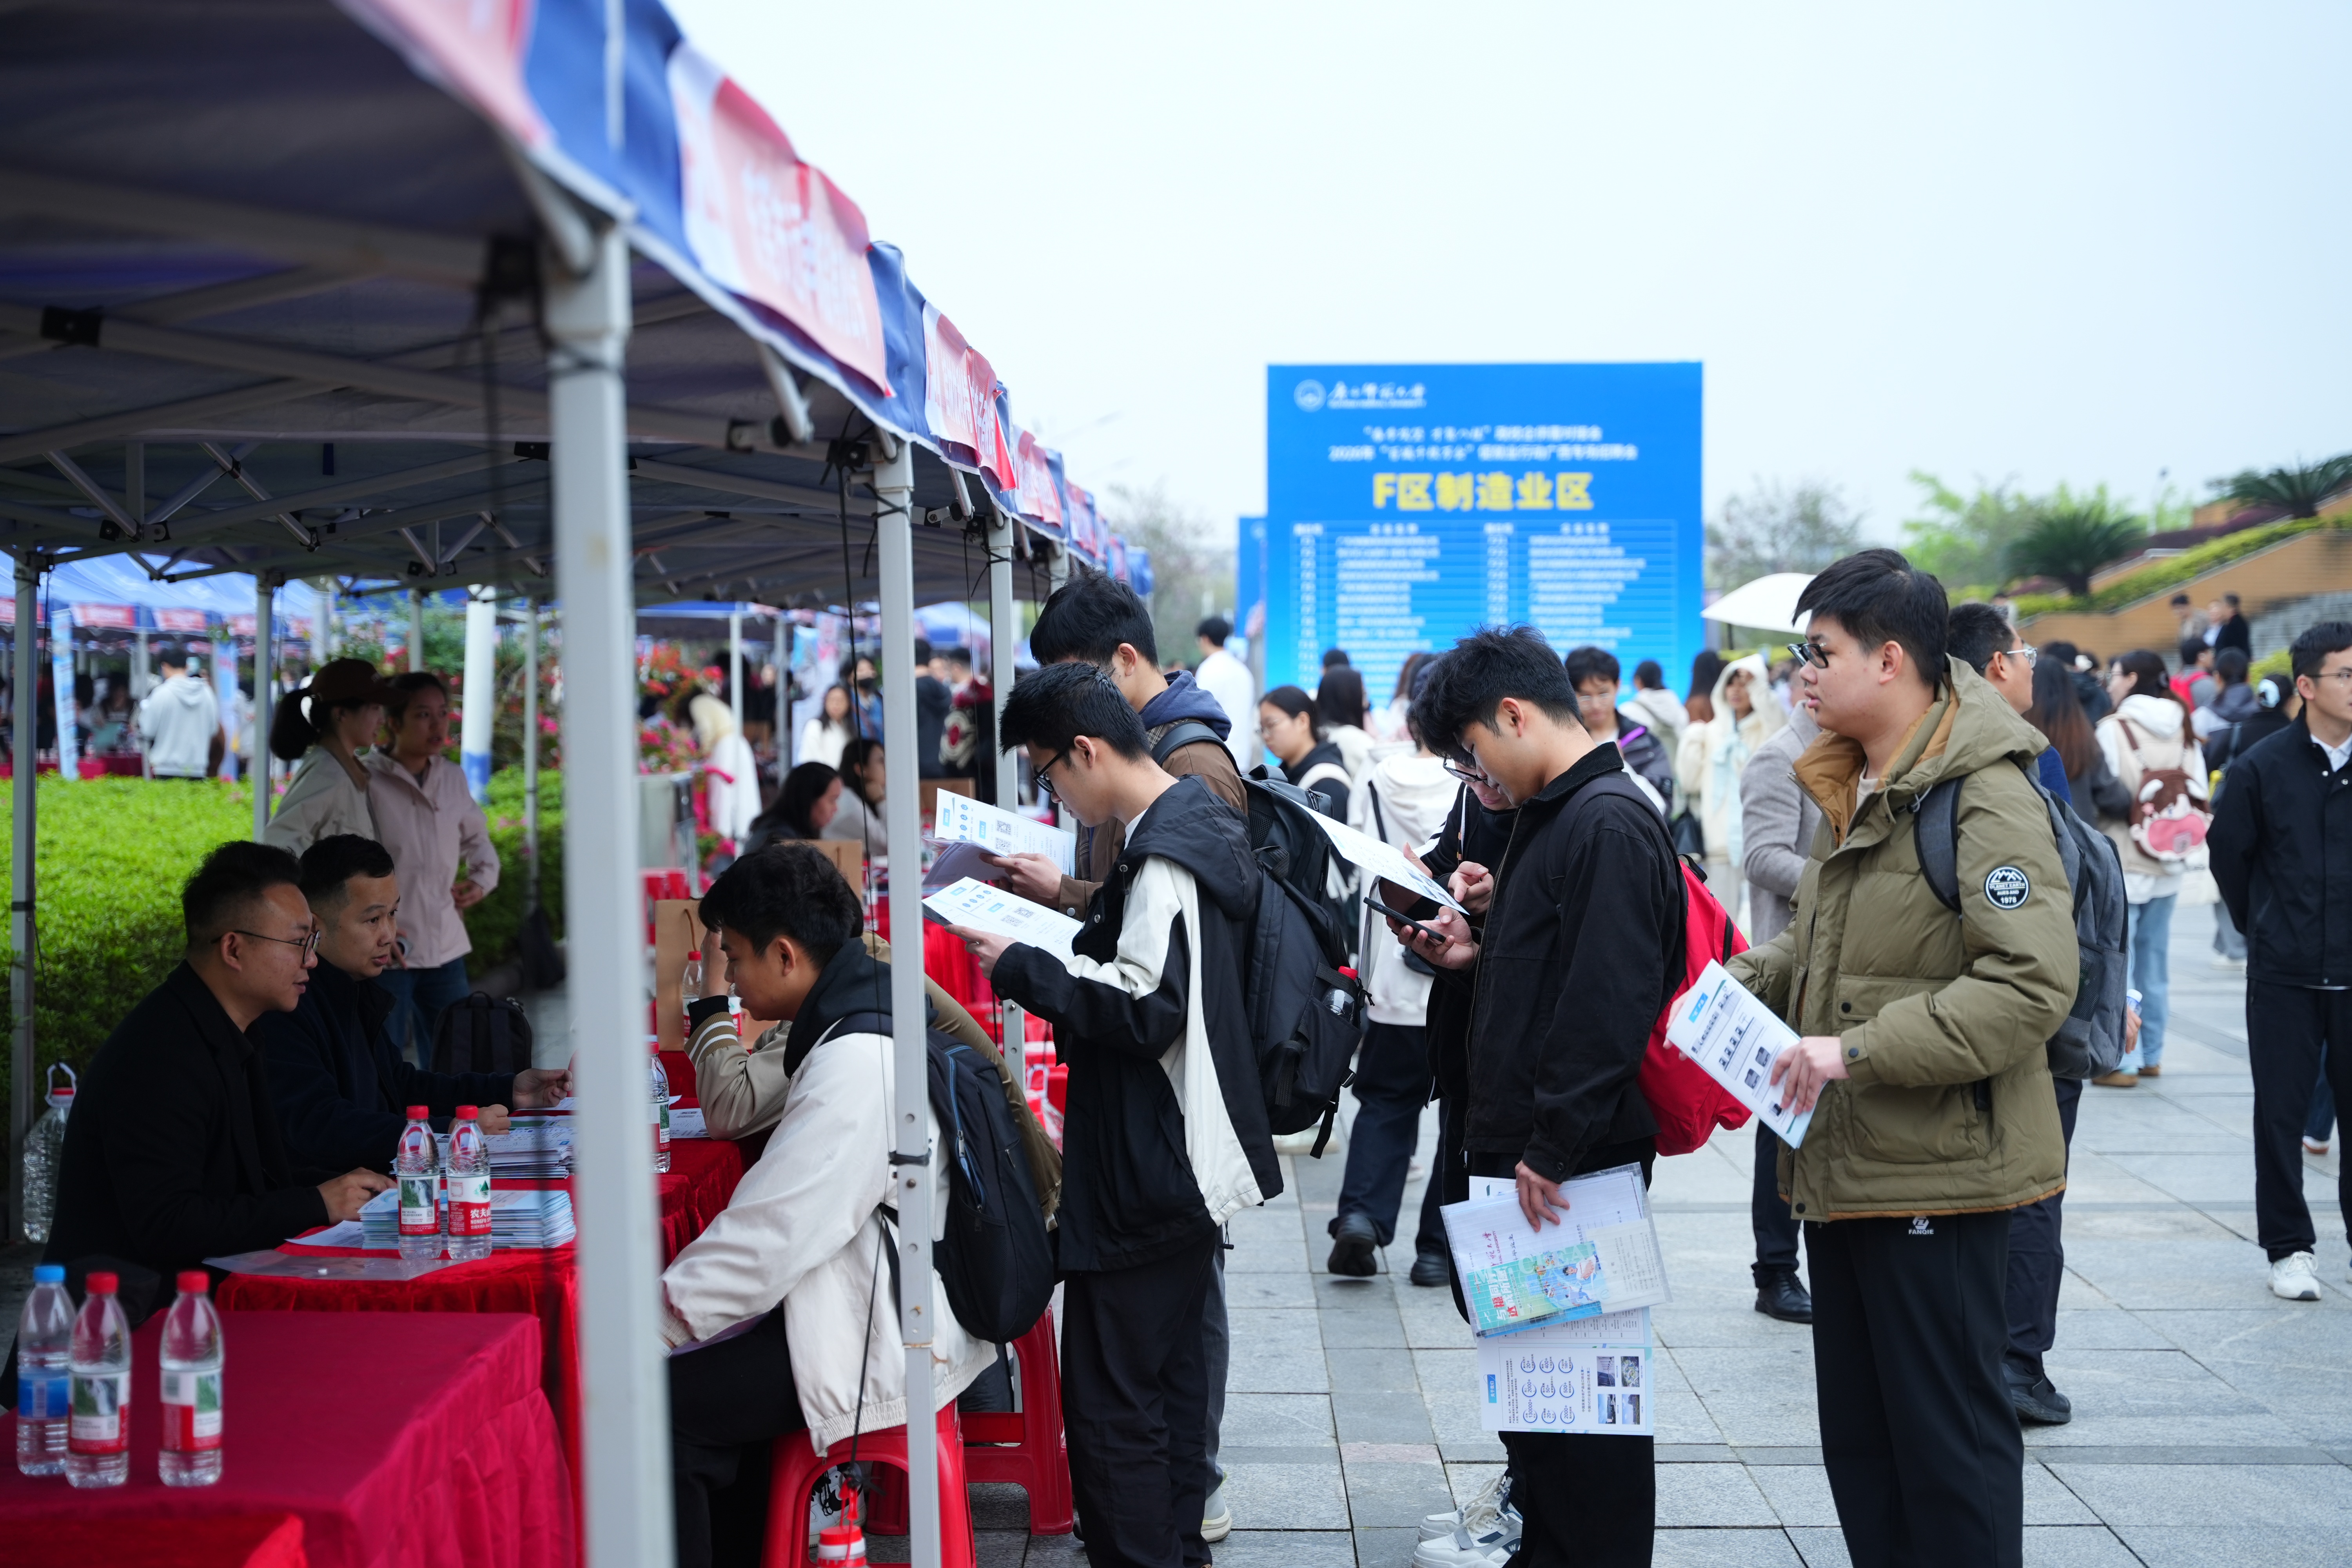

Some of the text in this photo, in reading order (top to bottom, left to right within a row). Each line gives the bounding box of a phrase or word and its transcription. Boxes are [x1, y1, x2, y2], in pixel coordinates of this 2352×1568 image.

[1372, 472, 1594, 511] F区制造业区
